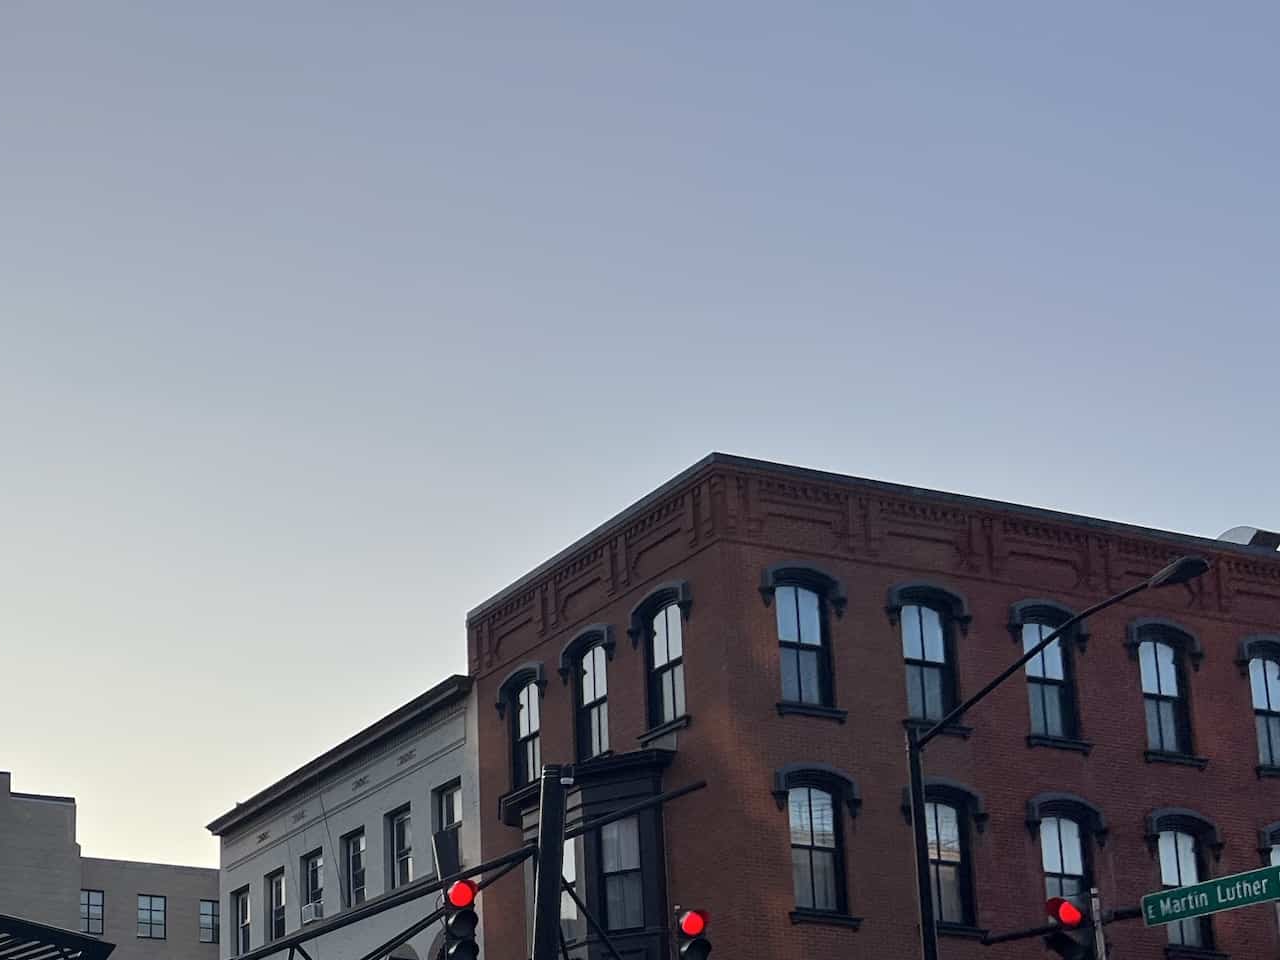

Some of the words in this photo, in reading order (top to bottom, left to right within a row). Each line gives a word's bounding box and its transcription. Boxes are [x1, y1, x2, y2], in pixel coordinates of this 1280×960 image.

[1147, 905, 1156, 919] E
[1160, 891, 1208, 917] Martin
[1217, 878, 1268, 903] Luther
